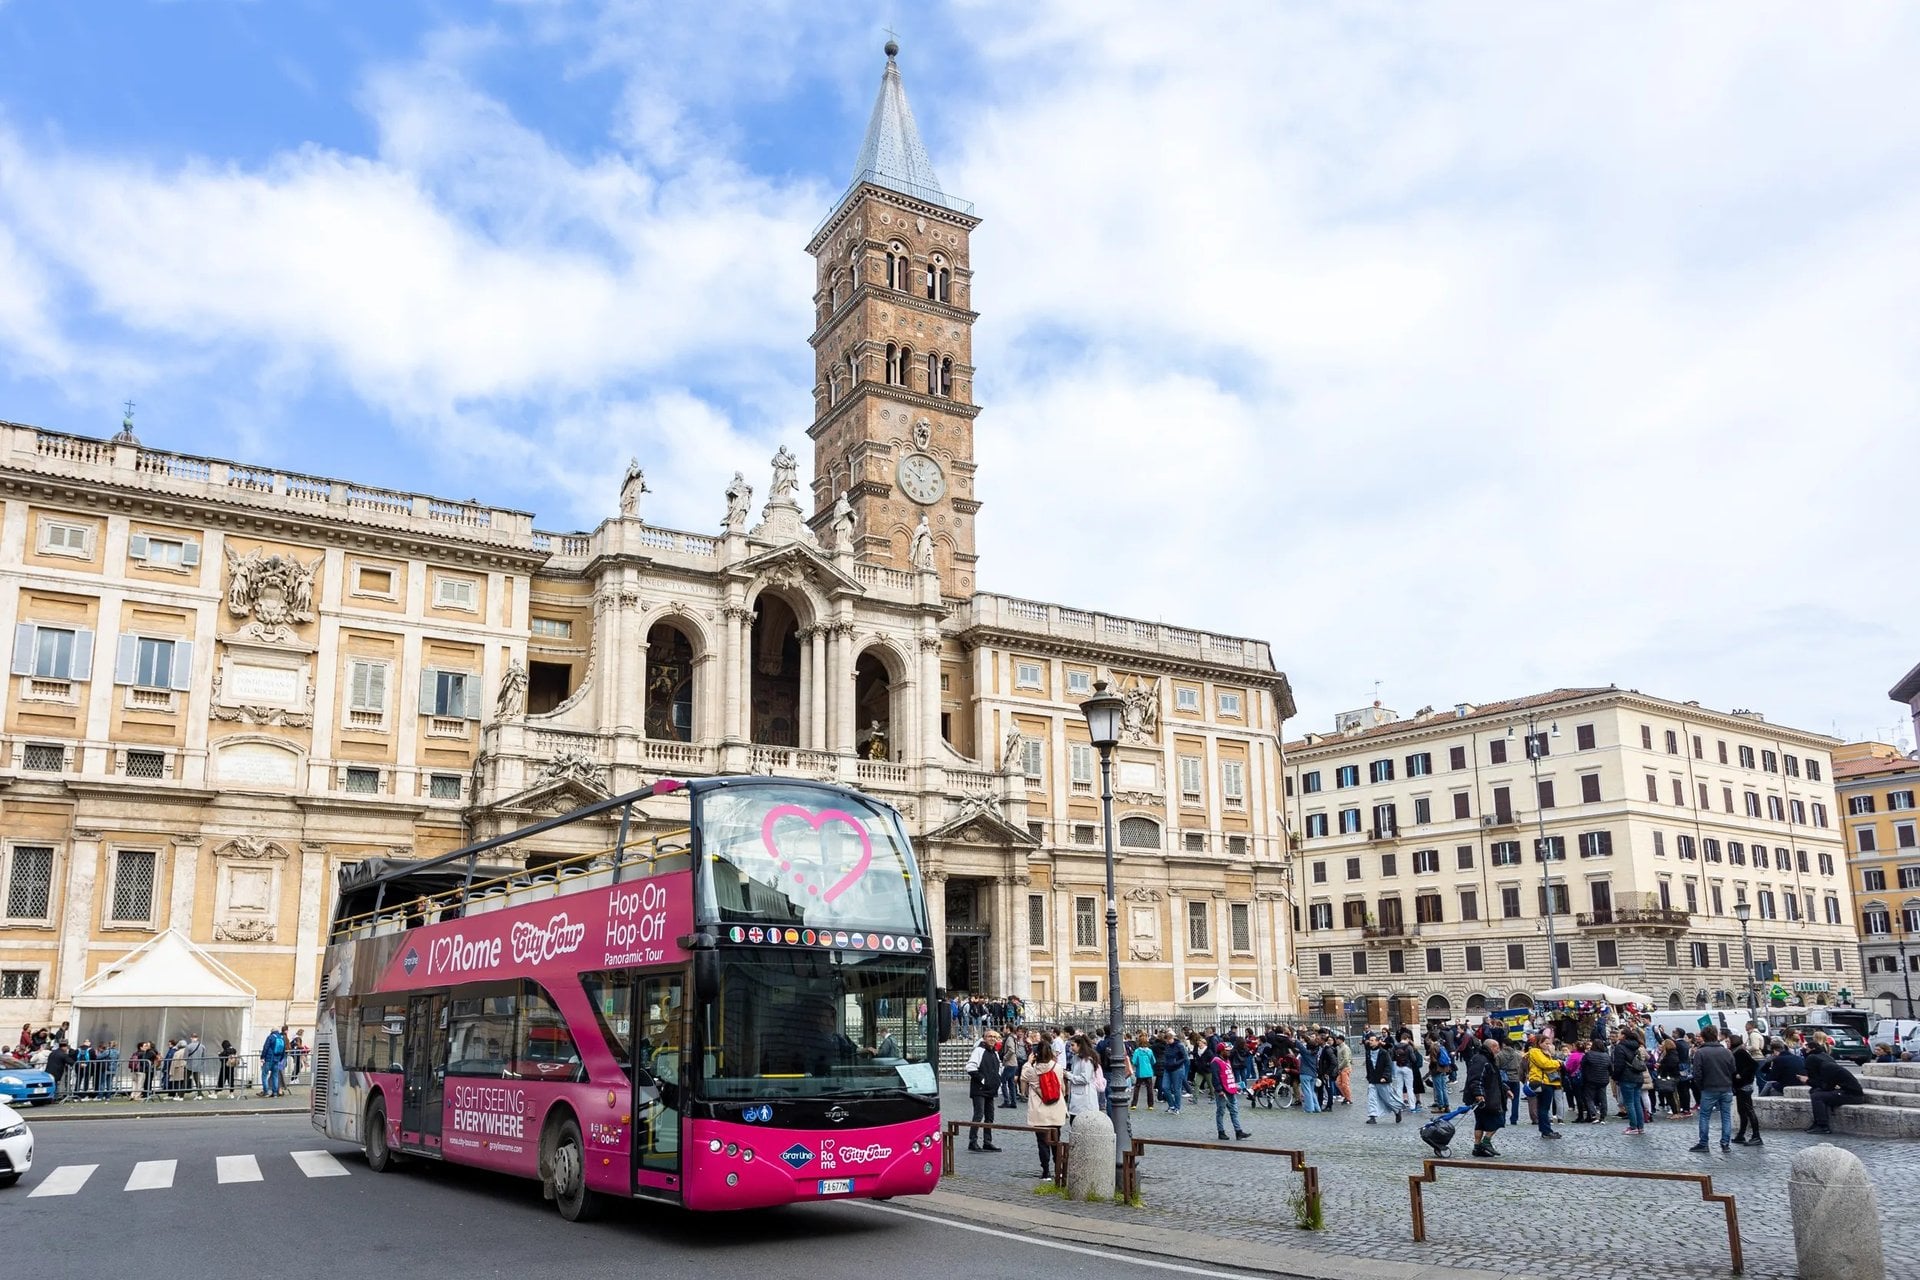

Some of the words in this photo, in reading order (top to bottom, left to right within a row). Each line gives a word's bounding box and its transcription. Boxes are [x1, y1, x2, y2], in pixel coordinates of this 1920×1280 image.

[511, 921, 547, 966] City
[543, 912, 585, 961] Tour
[427, 939, 435, 975] I
[450, 934, 502, 972] Rome
[604, 949, 643, 966] Panoramic
[645, 947, 664, 962] Tour
[1795, 982, 1831, 991] FARMACIA
[455, 1085, 525, 1114] SIGHTSEEING
[454, 1109, 524, 1139] EVERYWHERE
[839, 1147, 866, 1163] City
[866, 1144, 892, 1161] Tour
